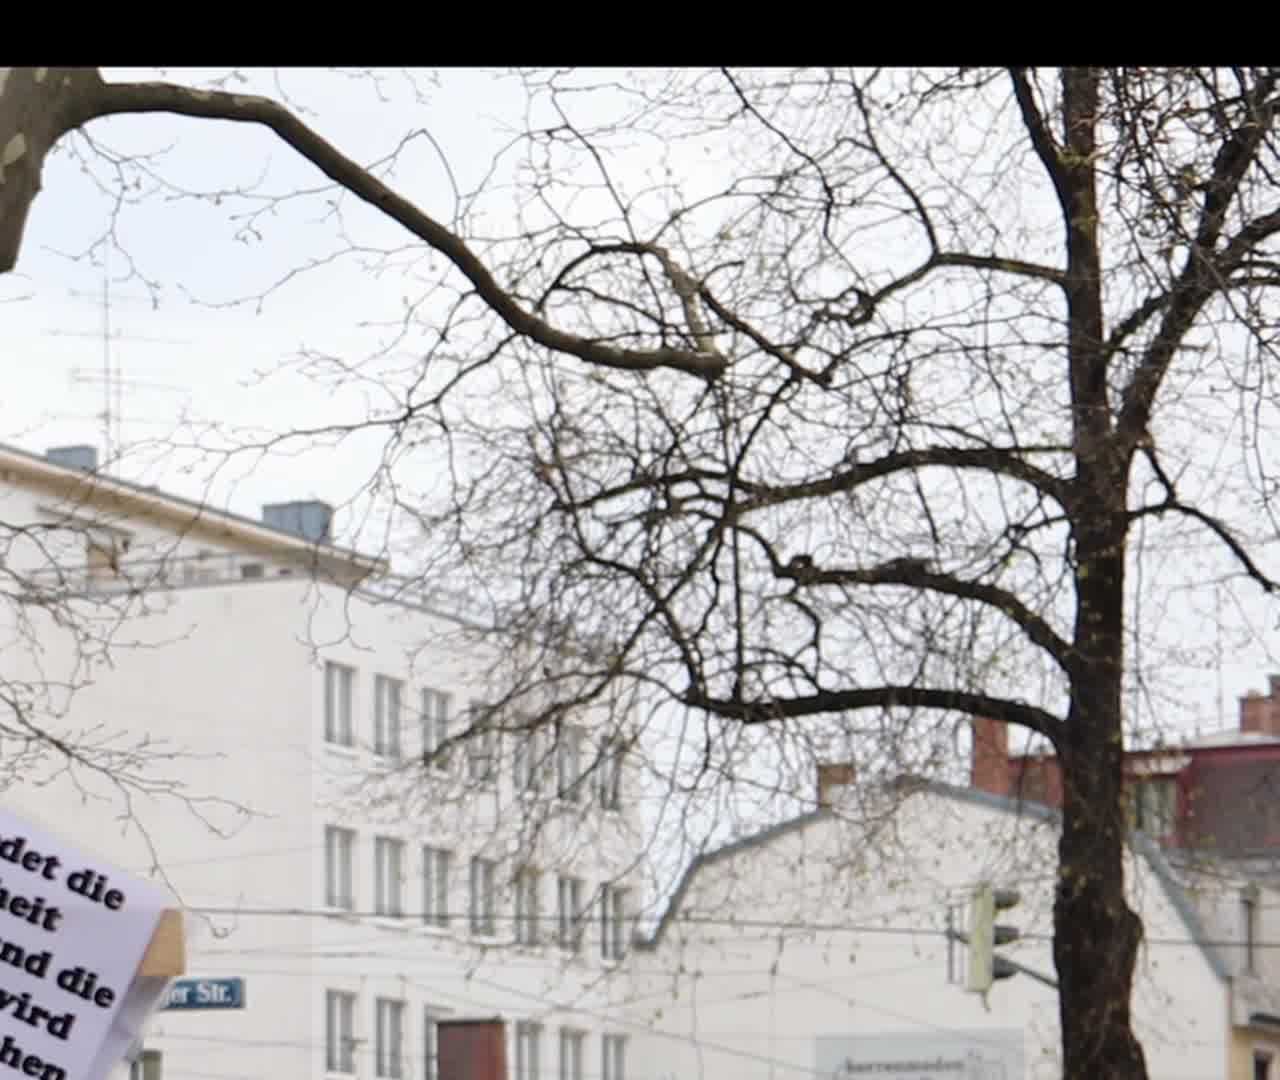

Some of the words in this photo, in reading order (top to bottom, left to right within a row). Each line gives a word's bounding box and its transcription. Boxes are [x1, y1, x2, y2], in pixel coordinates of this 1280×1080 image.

[67, 870, 124, 910] die
[57, 967, 114, 1008] die
[197, 981, 233, 1004] Str.
